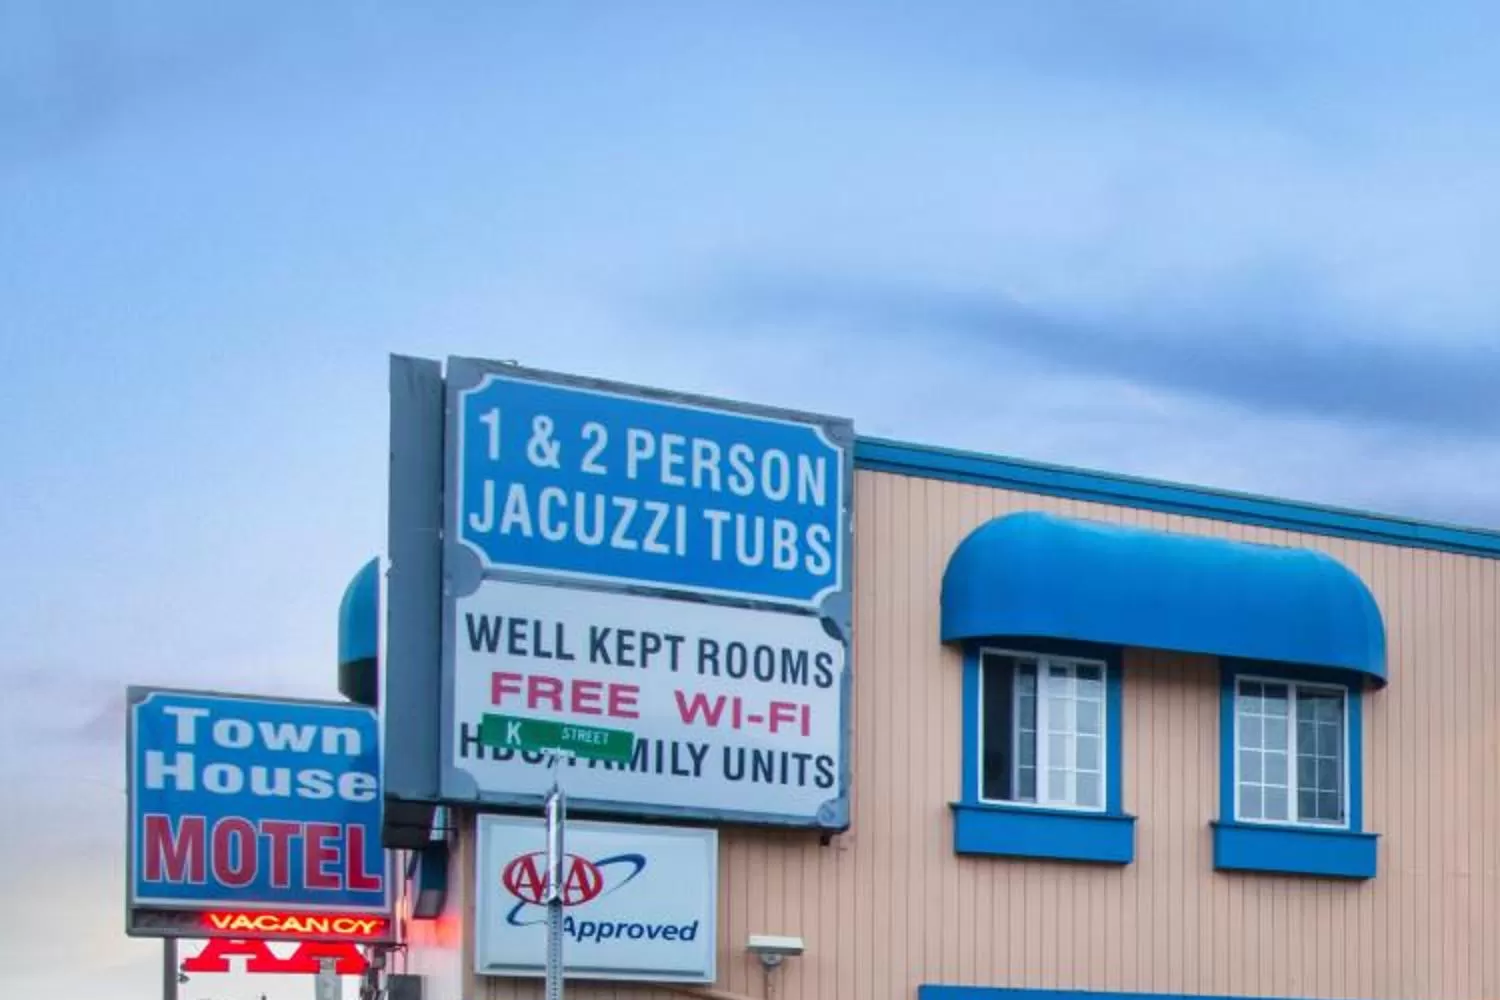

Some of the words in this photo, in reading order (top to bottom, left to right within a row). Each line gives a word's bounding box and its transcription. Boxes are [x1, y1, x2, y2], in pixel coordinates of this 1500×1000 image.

[480, 408, 500, 460] 1
[527, 414, 561, 468] &
[581, 422, 608, 475] 2
[626, 428, 826, 506] PERSON
[469, 480, 686, 556] JACUZZI
[703, 509, 832, 576] TUBS
[465, 613, 576, 661] WELL
[588, 625, 686, 673] KEPT
[698, 638, 834, 689] ROOMS
[491, 671, 640, 719] FREE
[674, 689, 811, 736] WI-FI
[163, 706, 362, 756] Town
[506, 721, 522, 745] K
[561, 727, 609, 744] STREET
[145, 750, 378, 802] House
[723, 747, 835, 789] UNITS
[143, 813, 383, 892] MOTEL
[508, 853, 599, 906] AA
[209, 914, 378, 935] VACANCY
[564, 915, 699, 943] Approved
